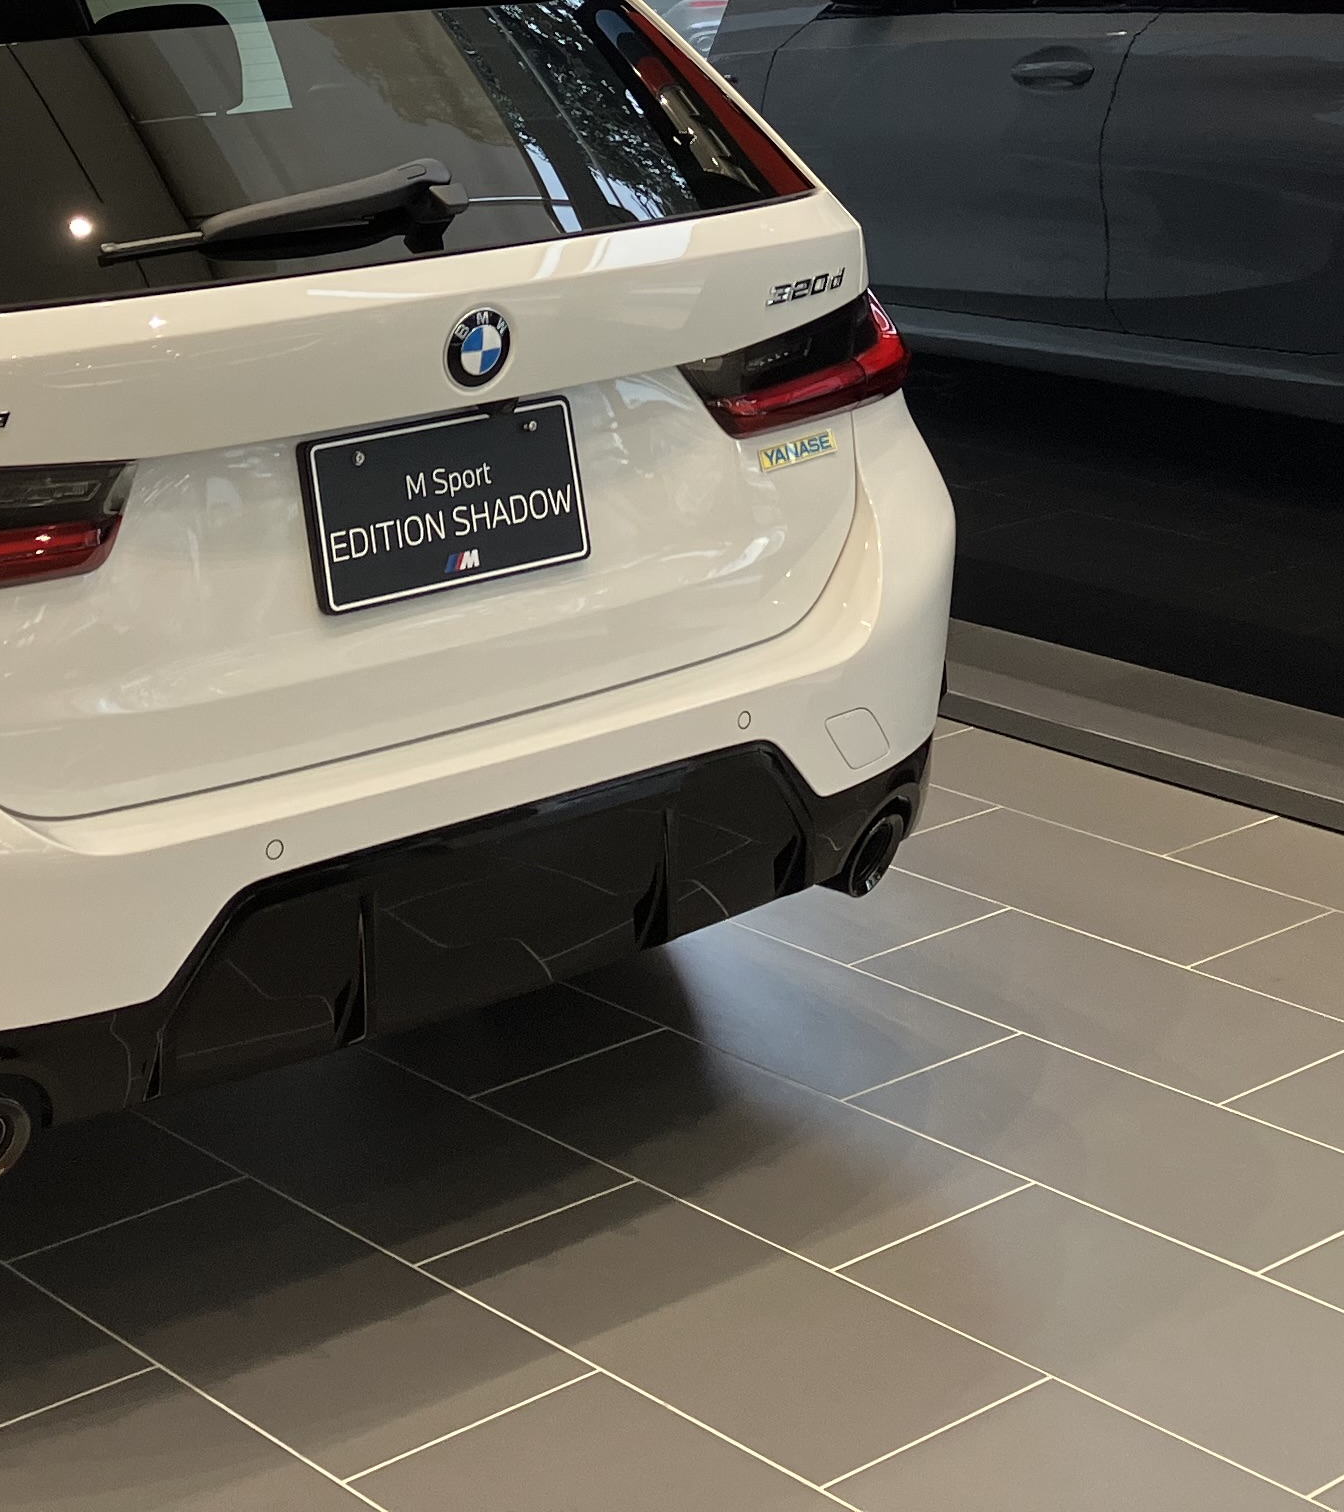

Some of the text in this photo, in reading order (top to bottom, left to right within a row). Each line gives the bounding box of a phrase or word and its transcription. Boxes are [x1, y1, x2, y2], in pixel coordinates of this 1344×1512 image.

[765, 266, 846, 307] 320d
[763, 433, 833, 466] YANASE
[405, 462, 492, 501] M Sport
[330, 484, 572, 563] EDITION SHADOW
